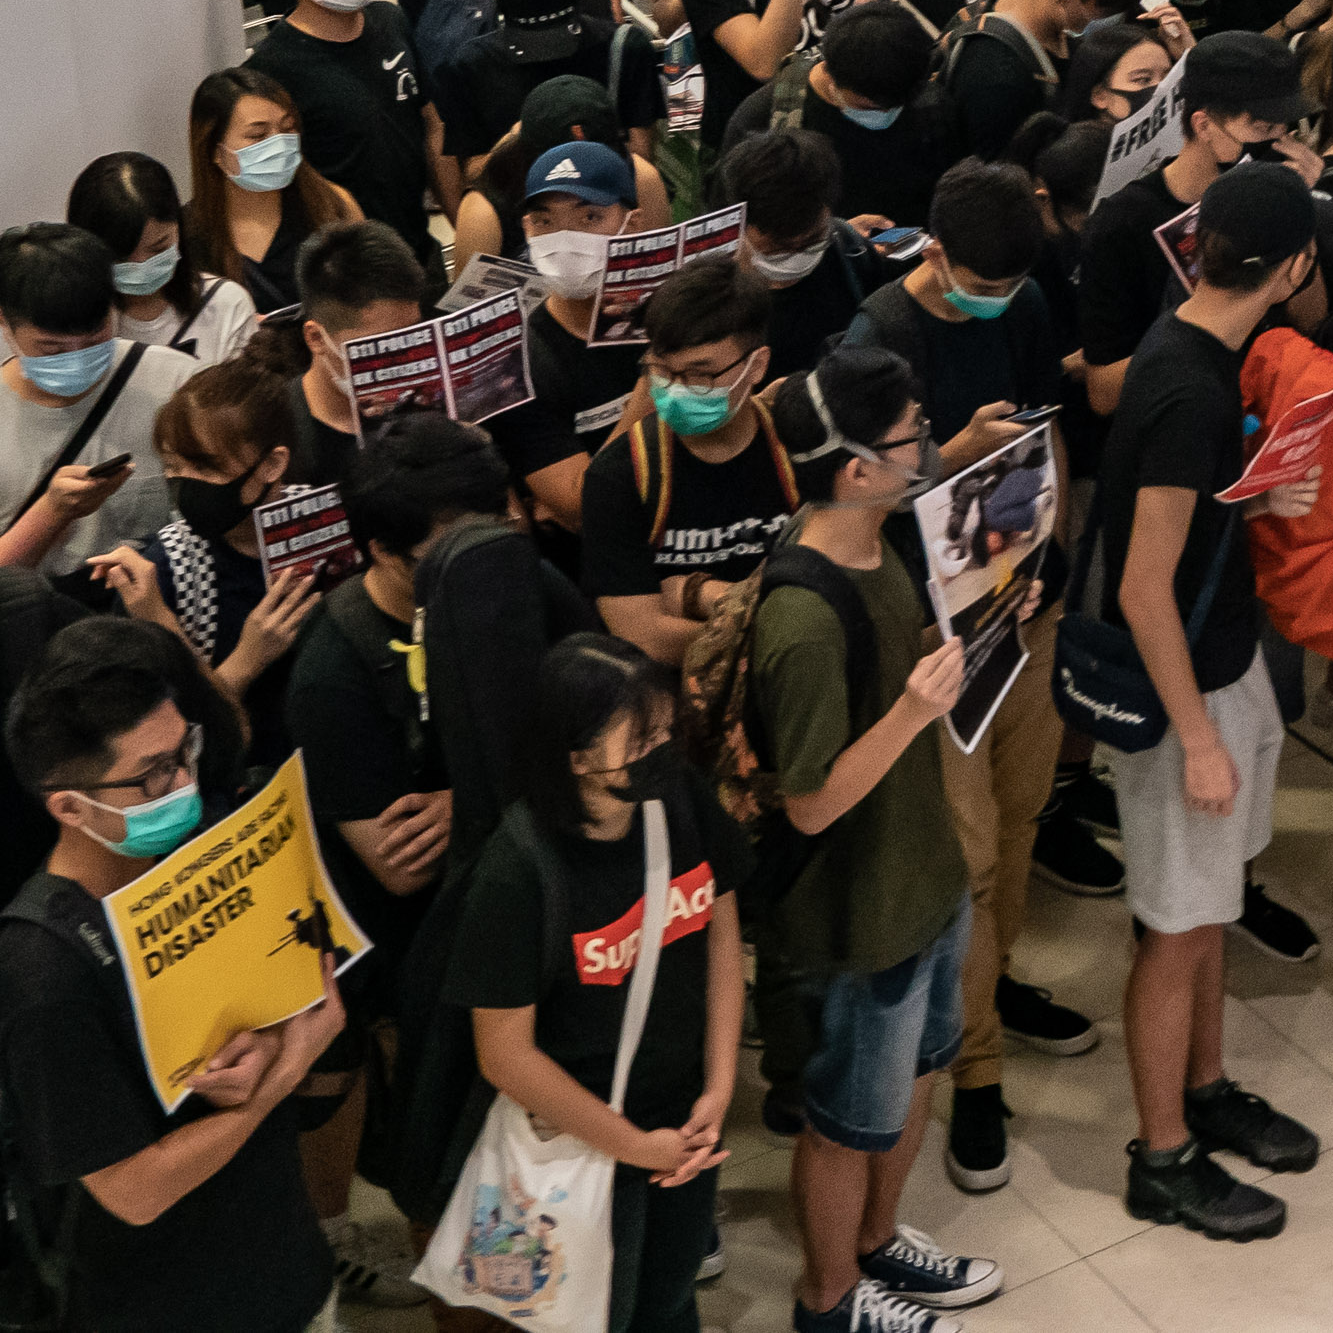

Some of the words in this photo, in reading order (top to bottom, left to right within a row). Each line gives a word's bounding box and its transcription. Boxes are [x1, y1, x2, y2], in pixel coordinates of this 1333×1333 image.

[705, 210, 742, 233] POLICE
[634, 231, 679, 253] POLICE
[470, 295, 518, 326] POLICE
[377, 328, 434, 355] POLICE
[290, 491, 343, 520] POLICE
[134, 815, 297, 950] HUMANITARIAN
[128, 881, 172, 916] HONG
[142, 885, 256, 980] DISASTER
